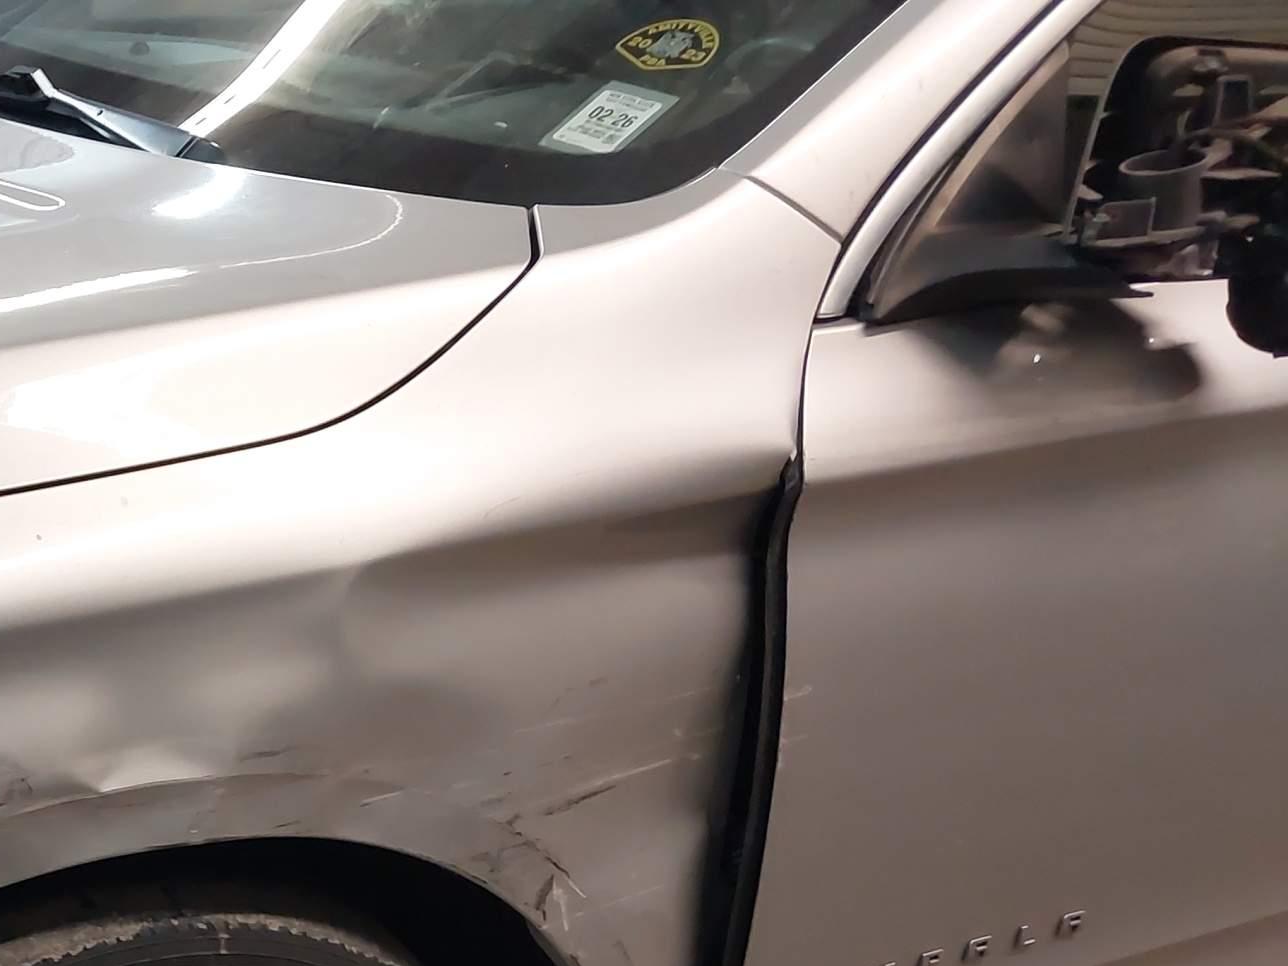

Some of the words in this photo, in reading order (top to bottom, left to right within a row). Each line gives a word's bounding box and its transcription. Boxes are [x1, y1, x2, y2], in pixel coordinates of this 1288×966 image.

[626, 36, 652, 49] 20
[679, 48, 707, 62] 23
[588, 105, 614, 122] 02
[610, 112, 638, 129] 26
